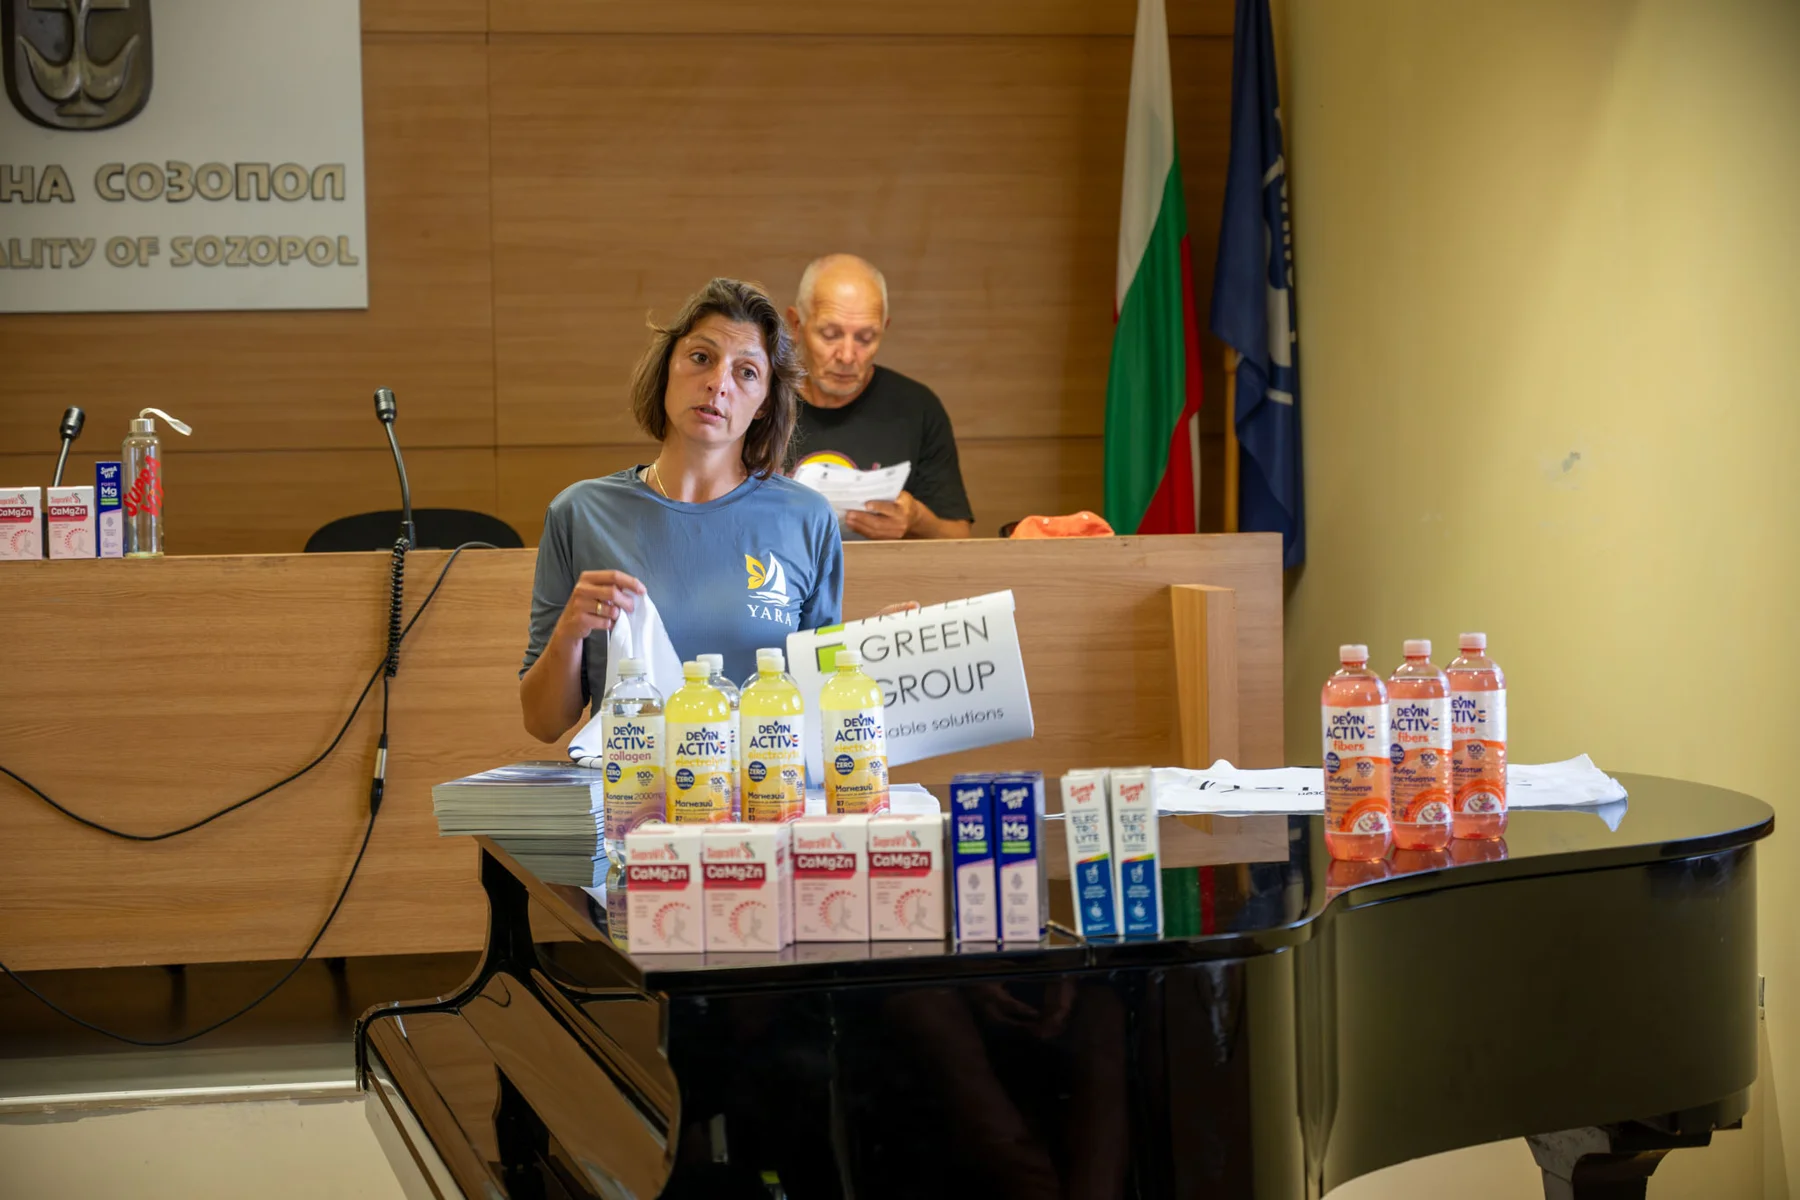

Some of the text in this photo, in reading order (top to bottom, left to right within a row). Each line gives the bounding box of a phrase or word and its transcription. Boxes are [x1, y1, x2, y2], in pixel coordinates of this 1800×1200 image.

[94, 160, 346, 202] СОЗОПОЛ
[105, 236, 159, 268] OF
[170, 235, 359, 267] SOZOPOL
[101, 486, 117, 497] Mg
[51, 505, 86, 516] CaMgZn
[747, 604, 792, 626] YARA
[860, 615, 989, 663] GREEN
[1452, 697, 1476, 709] EVIN
[1397, 705, 1429, 717] DEVIN
[1452, 710, 1486, 723] TIVE
[843, 714, 875, 728] DEVIN
[931, 708, 1004, 731] solutions
[1333, 712, 1365, 725] DEVIN
[1390, 717, 1439, 731] ACTIVE
[613, 723, 645, 736] DEVIN
[686, 728, 719, 741] DEVIN
[758, 721, 791, 734] DEVIN
[834, 726, 883, 742] ACTIVE
[1326, 725, 1375, 740] ACTIVE
[1452, 724, 1475, 735] bers
[606, 736, 655, 750] ACTIVE
[749, 734, 799, 749] ACTIVE
[1398, 732, 1429, 743] fibers
[676, 742, 726, 756] ACTIVE
[1333, 740, 1365, 751] fibers
[609, 750, 652, 764] collagen
[959, 822, 985, 840] Mg
[1002, 822, 1029, 840] Mg
[1121, 833, 1146, 843] LYTE
[1075, 833, 1099, 844] LYTE
[798, 854, 854, 870] CaMgZn
[872, 853, 929, 869] CaMgZn
[630, 866, 687, 882] CaMgZn
[706, 864, 763, 881] CaMgZn
